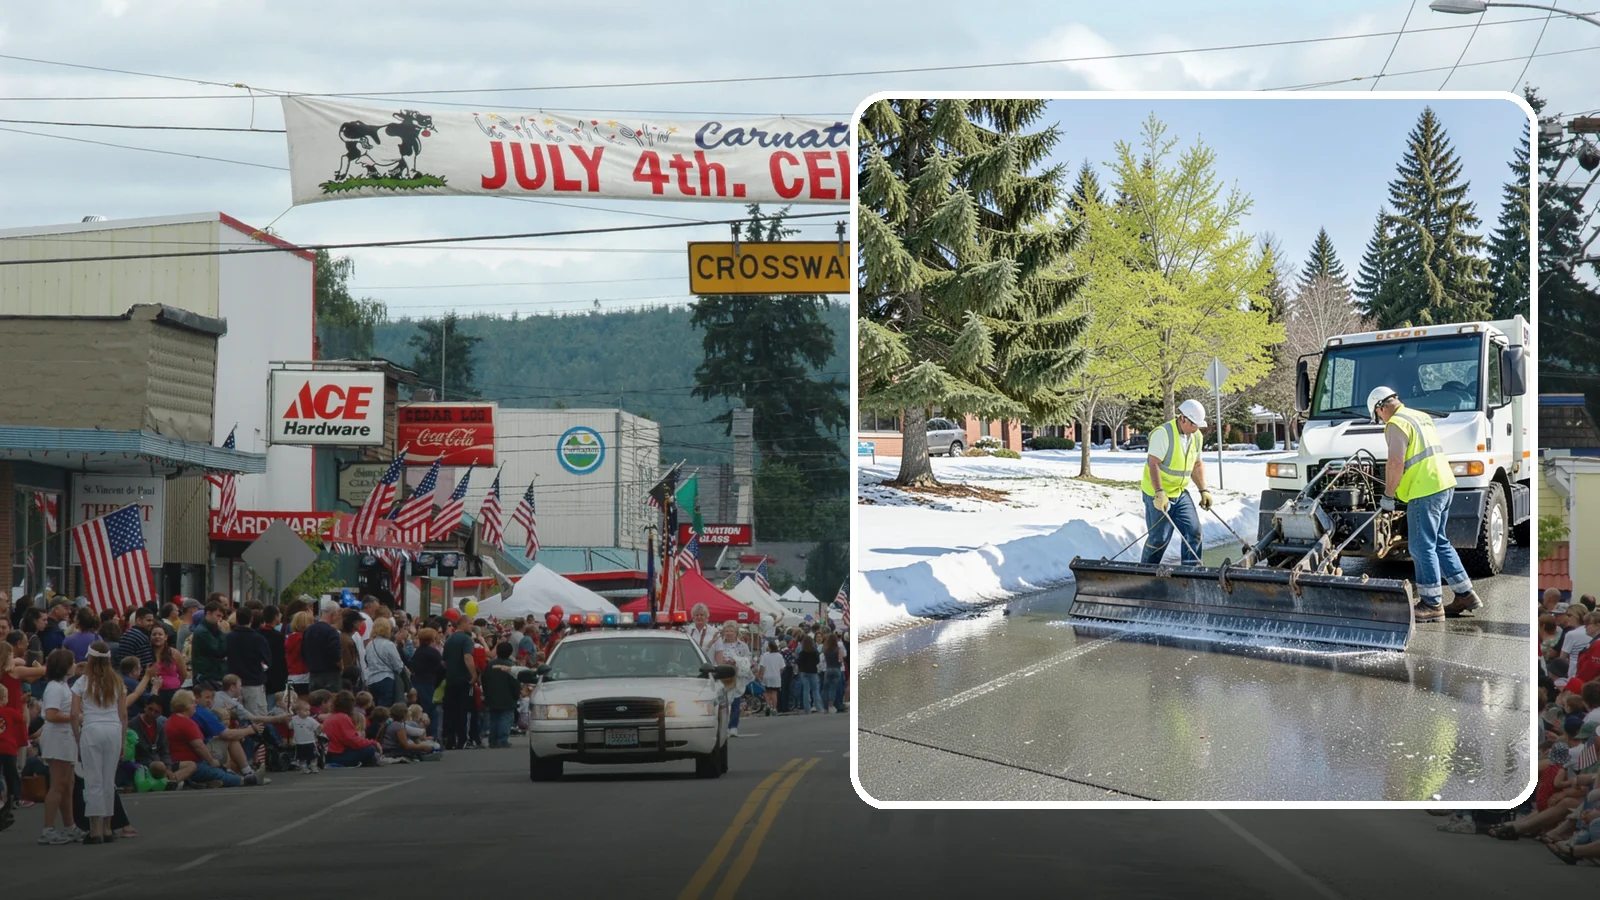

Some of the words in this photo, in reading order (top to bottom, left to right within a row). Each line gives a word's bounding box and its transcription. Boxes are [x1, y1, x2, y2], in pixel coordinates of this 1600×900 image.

[695, 121, 850, 150] Carnat
[481, 142, 605, 193] JULY
[633, 149, 746, 199] 4th.
[697, 254, 850, 280] CROSSWA
[283, 380, 373, 420] ACE
[406, 409, 452, 421] CEDAR
[283, 421, 371, 437] Hardware
[416, 427, 477, 447] Coca-Cola
[353, 467, 384, 480] Simpl
[94, 485, 124, 494] Vincent
[126, 485, 136, 495] de
[137, 485, 155, 495] Paul
[688, 526, 741, 535] CRNATION
[699, 535, 730, 543] GLASS
